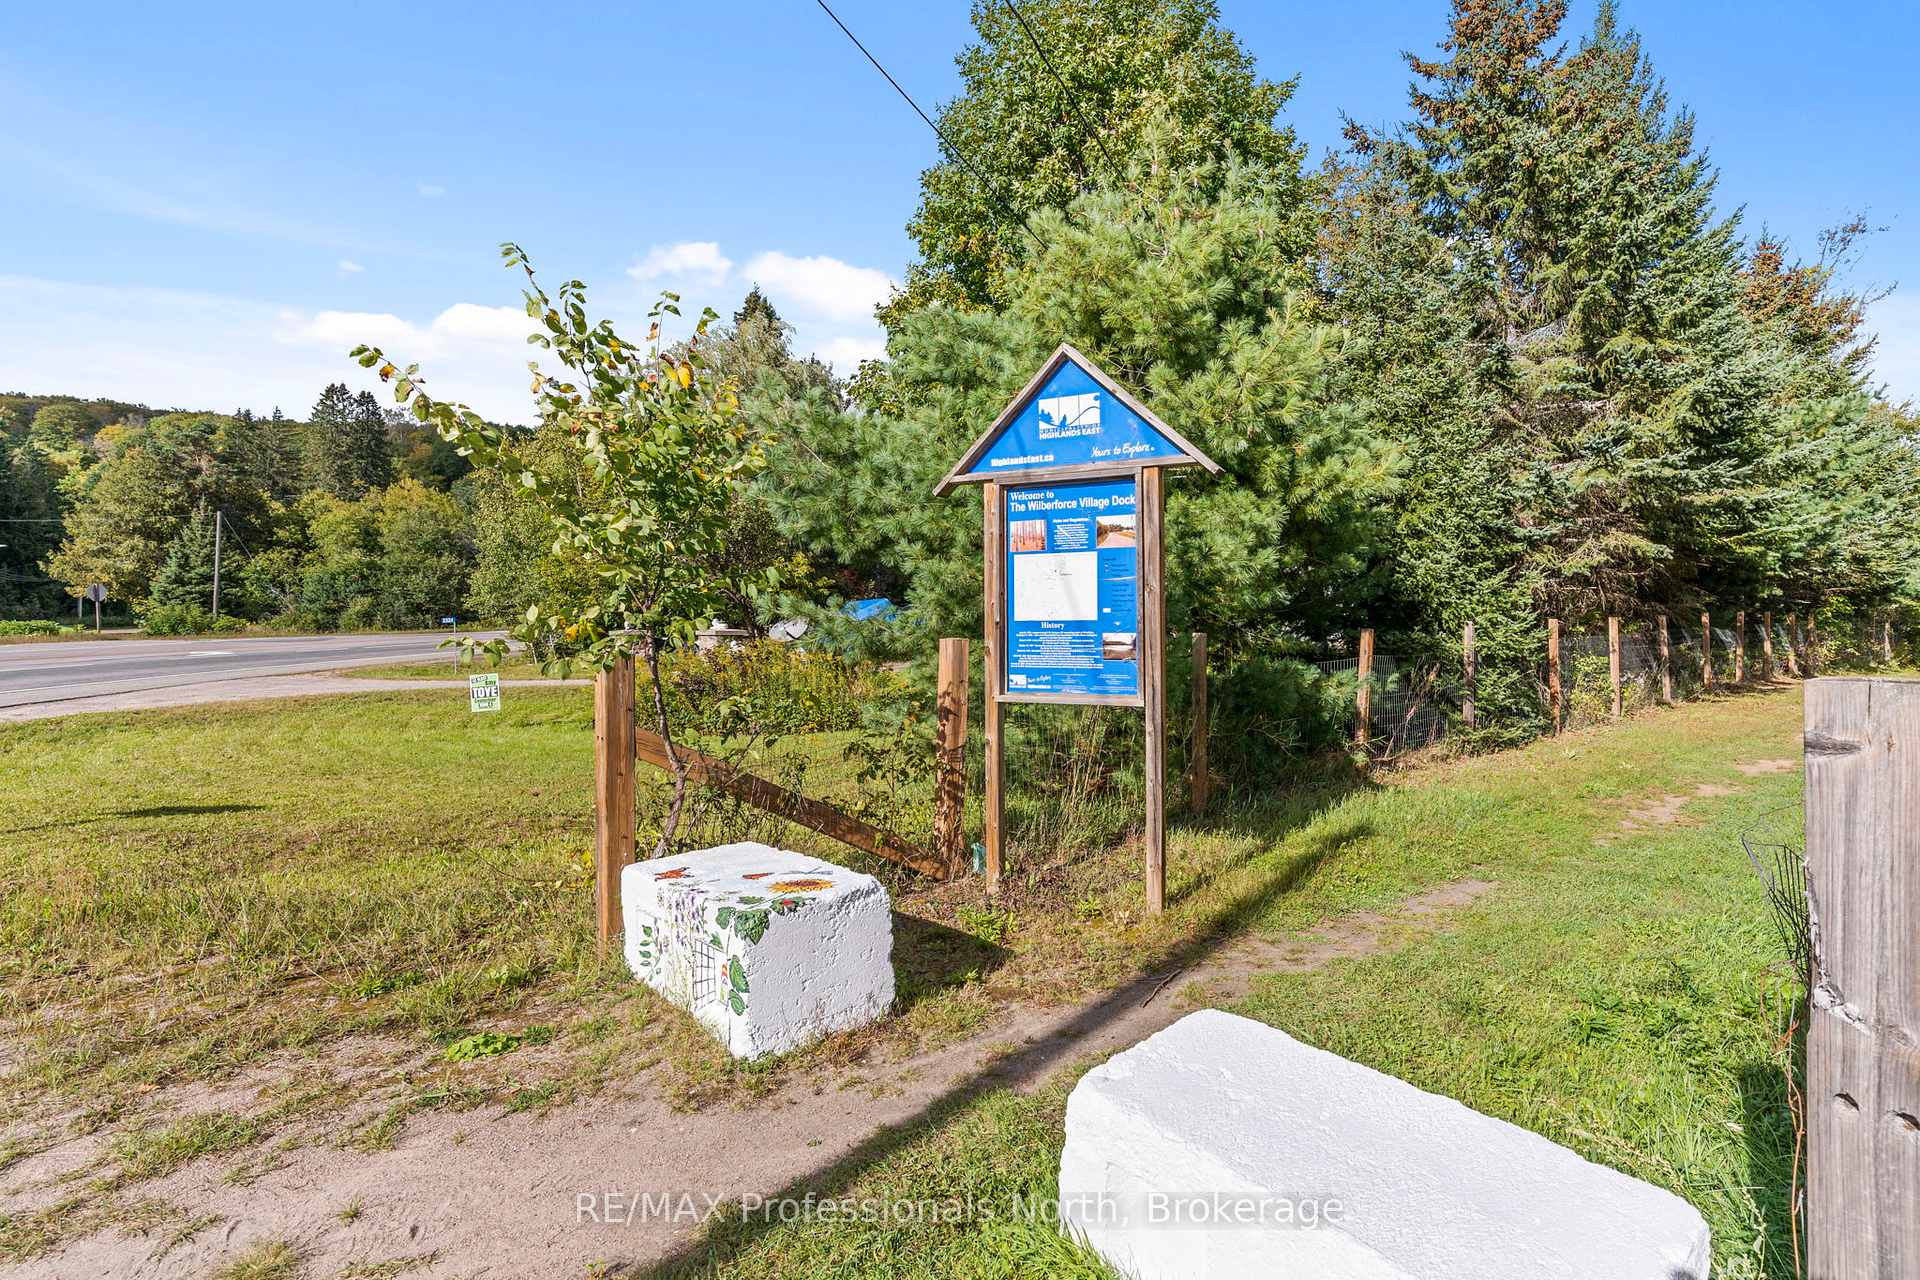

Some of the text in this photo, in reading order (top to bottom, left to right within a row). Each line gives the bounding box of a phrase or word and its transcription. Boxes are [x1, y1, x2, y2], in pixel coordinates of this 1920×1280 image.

[1040, 429, 1081, 440] HIGHLANDS
[1082, 427, 1101, 436] EAST
[1113, 445, 1121, 455] to
[1010, 490, 1054, 501] Welcome to
[1010, 495, 1136, 512] The Wilberforce Village Dock
[1041, 621, 1065, 630] History
[473, 686, 498, 698] TOYE
